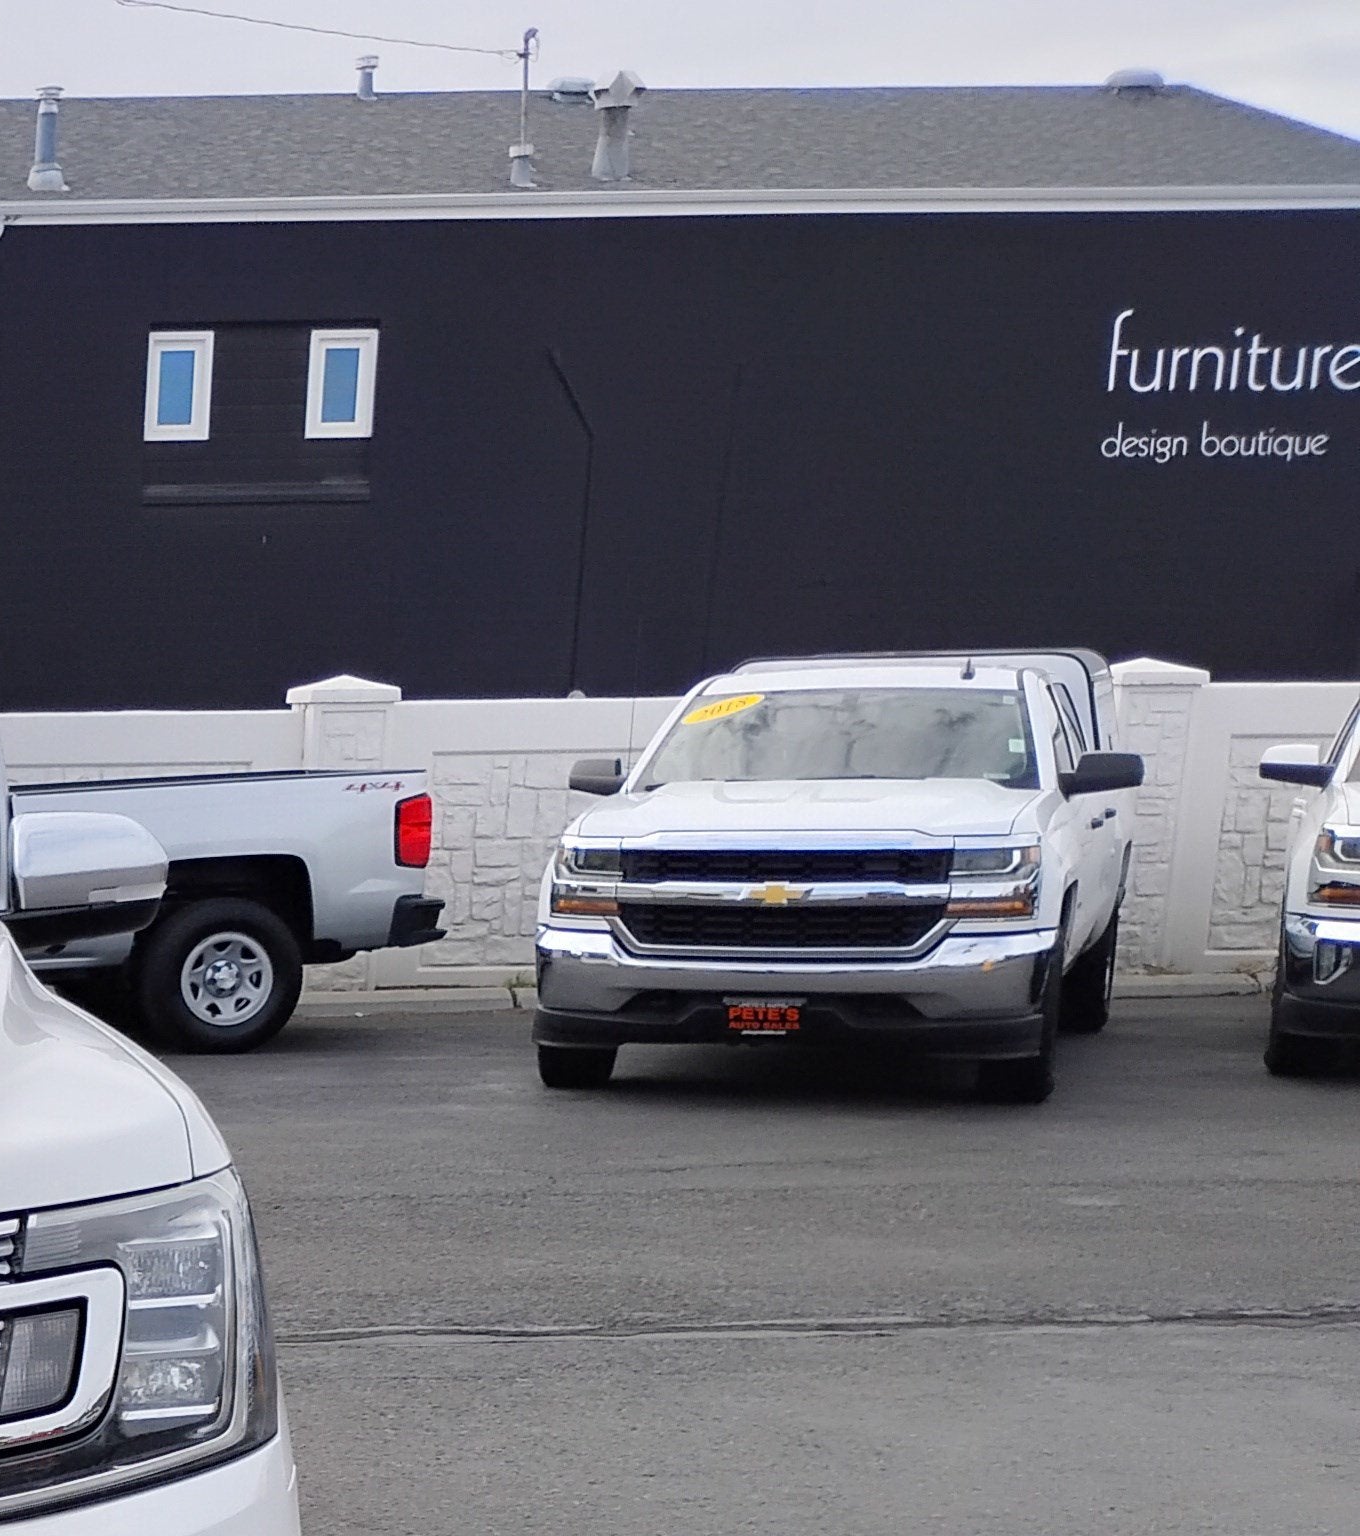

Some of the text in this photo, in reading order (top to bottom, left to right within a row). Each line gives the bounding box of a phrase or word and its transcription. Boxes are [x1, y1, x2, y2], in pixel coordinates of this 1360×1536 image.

[1107, 308, 1360, 393] furniture
[1100, 420, 1330, 464] design boutique
[728, 1007, 799, 1020] PETE'S
